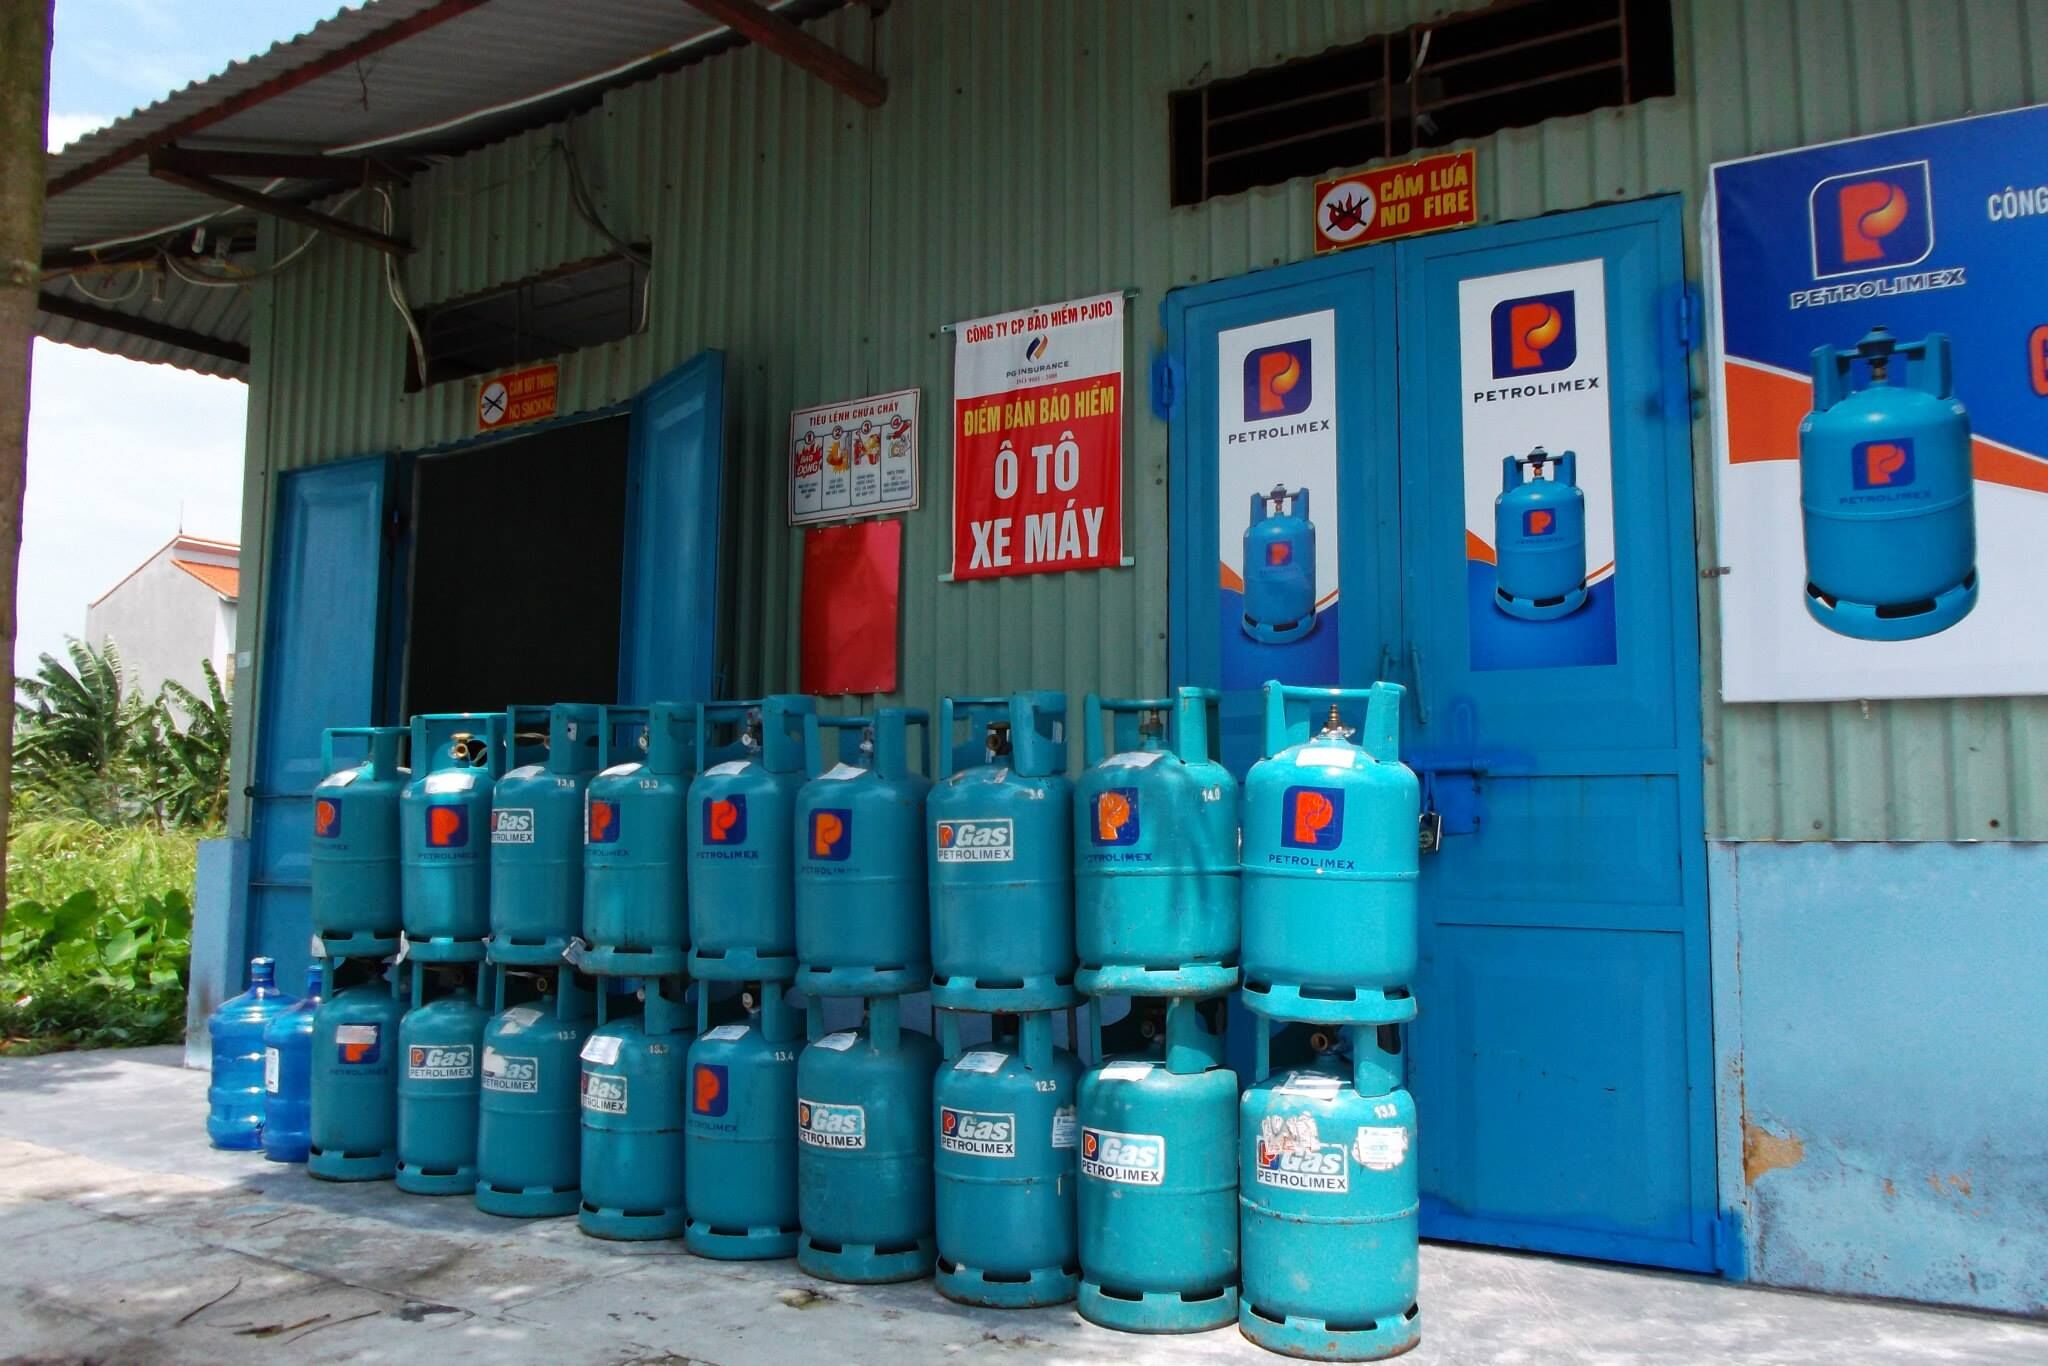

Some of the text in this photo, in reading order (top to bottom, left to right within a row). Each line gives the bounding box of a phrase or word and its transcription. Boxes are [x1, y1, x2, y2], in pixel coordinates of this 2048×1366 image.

[1381, 190, 1469, 228] NO FIRE
[1790, 268, 1967, 310] PETROLIMEX
[966, 324, 994, 344] CÔNG
[996, 322, 1008, 338] TY
[1011, 318, 1025, 335] CP
[1081, 299, 1113, 321] PJICO
[1018, 360, 1069, 376] INSURANCE
[1473, 376, 1600, 404] PETROLIMEX
[509, 405, 521, 419] NO
[964, 380, 1115, 437] ĐIỂM BÁN BẢO HIỂM
[1228, 419, 1330, 444] PETROLIMEX
[995, 430, 1080, 500] Ô TÔ
[969, 498, 1104, 569] XE MÁY
[498, 811, 531, 831] Gas
[956, 823, 1009, 848] Gas
[938, 848, 1011, 861] PETROLIMEX
[1084, 852, 1153, 863] ETROLIMEX
[1268, 853, 1355, 870] PETROLIMEX
[425, 1048, 470, 1067] Gas
[410, 1067, 473, 1079] PETROLIMEX
[588, 1076, 622, 1100] Gas
[1034, 1079, 1057, 1093] 12.5
[812, 1107, 858, 1134] Gas
[958, 1115, 1010, 1142] Gas
[941, 1137, 1014, 1154] PETROLIMEX
[1101, 1137, 1157, 1168] Gas
[1082, 1159, 1160, 1183] PETROLIMEX
[1280, 1149, 1342, 1176] Gas
[1258, 1170, 1347, 1190] PETROLIMEX
